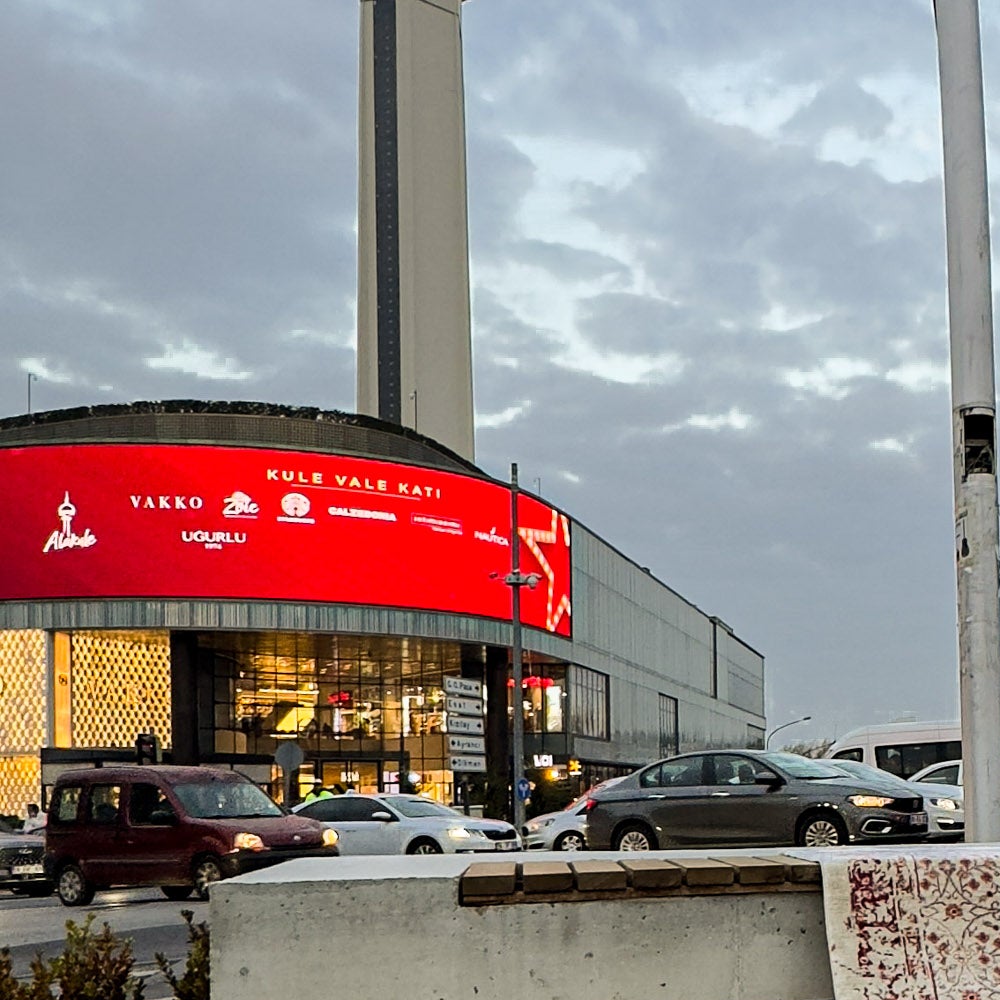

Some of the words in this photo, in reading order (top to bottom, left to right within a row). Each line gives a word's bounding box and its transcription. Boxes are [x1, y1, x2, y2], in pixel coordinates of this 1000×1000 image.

[267, 469, 323, 484] KULE
[335, 475, 388, 491] VALE
[398, 483, 441, 500] KATI
[130, 496, 203, 509] VAKKO
